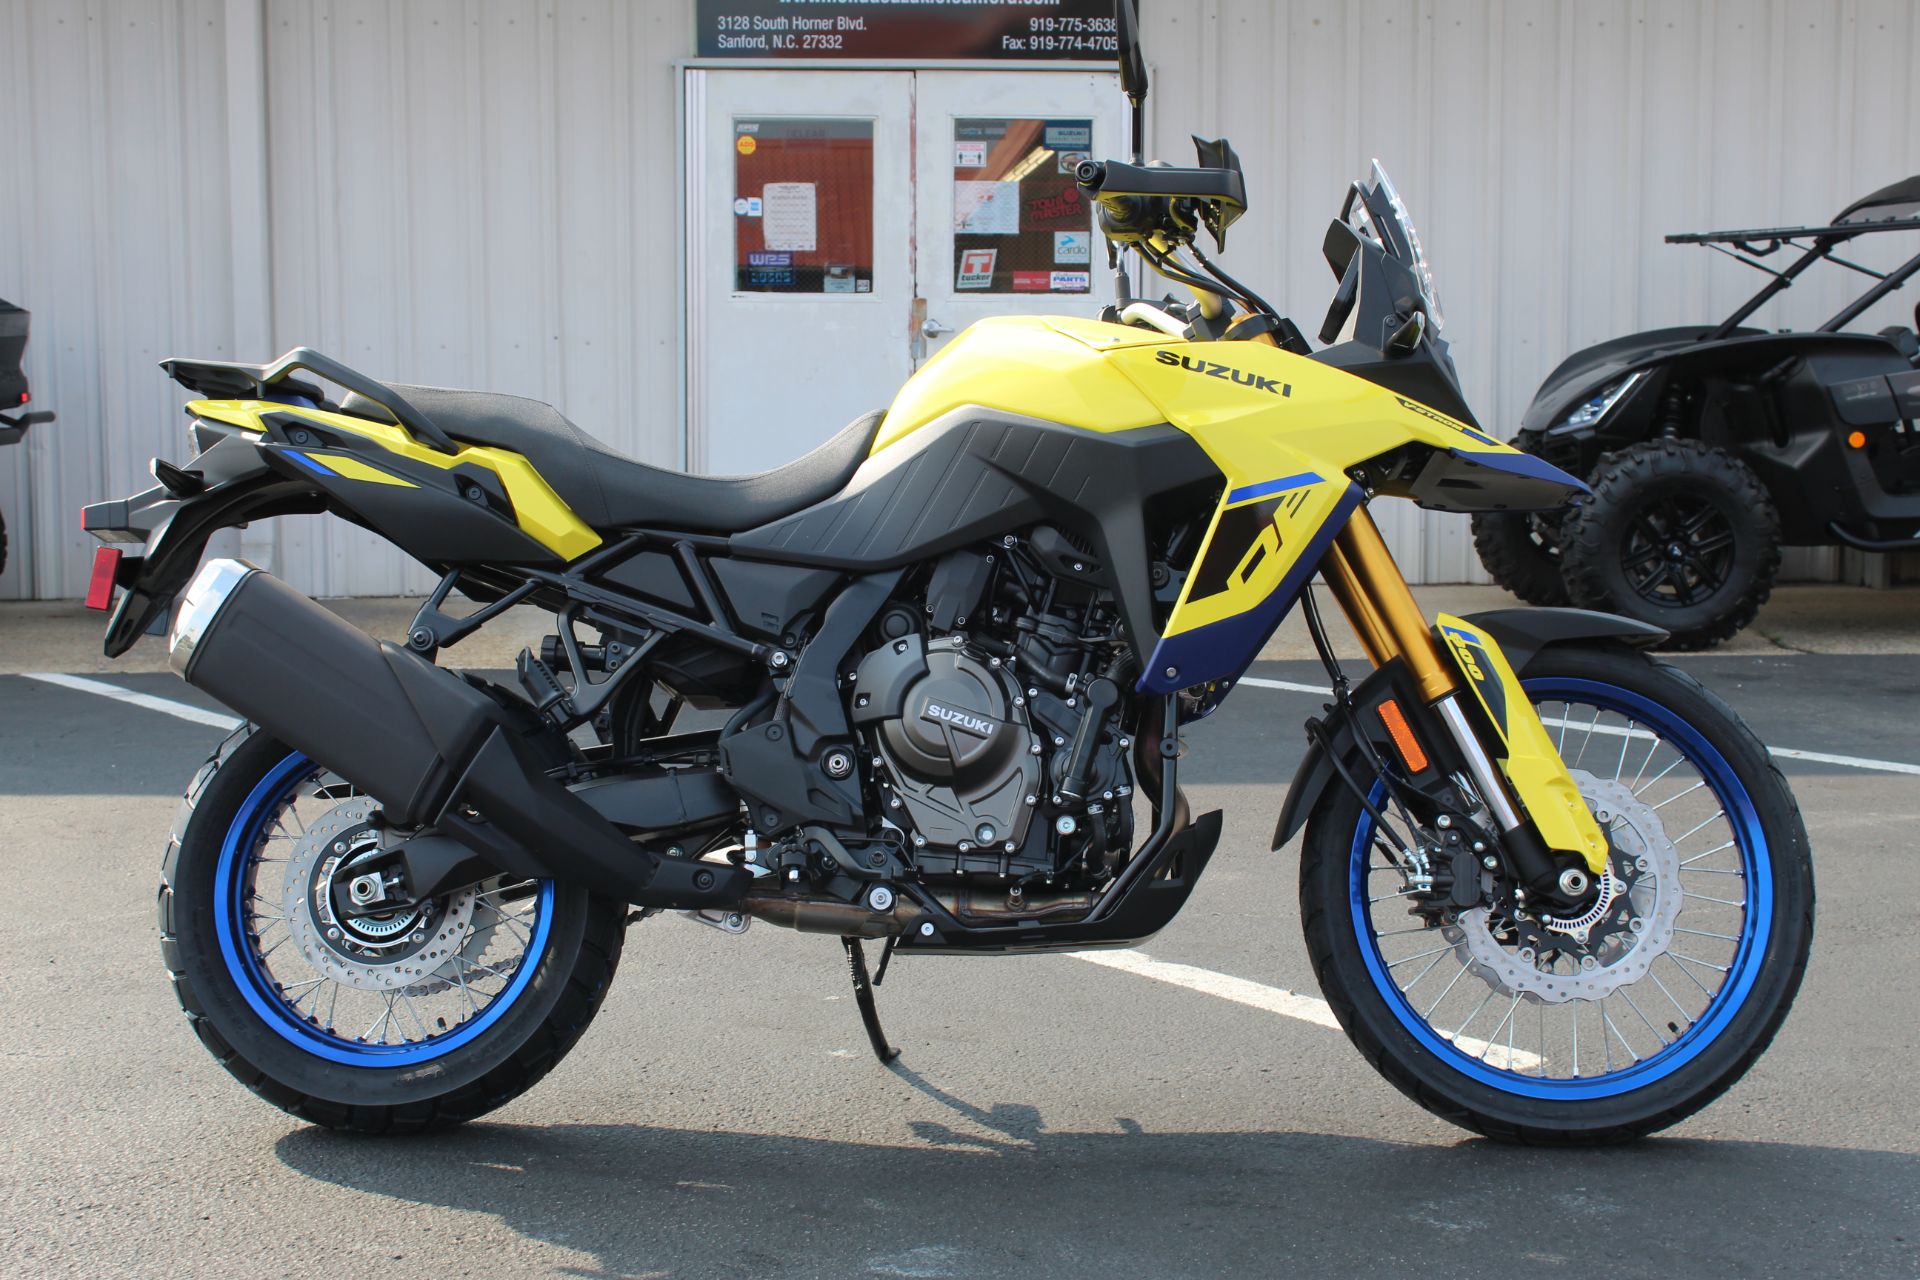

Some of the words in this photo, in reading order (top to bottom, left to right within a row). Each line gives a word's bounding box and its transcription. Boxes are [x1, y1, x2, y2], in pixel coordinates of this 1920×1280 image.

[717, 15, 750, 31] 3128
[753, 15, 789, 31] South
[792, 15, 833, 31] Horner
[837, 15, 867, 31] Blvd.
[1030, 17, 1117, 32] 919-775-3638
[717, 33, 769, 50] Sanford,
[772, 34, 799, 49] N.C.
[802, 34, 843, 49] 27332
[1002, 36, 1026, 50] Fax:
[1030, 36, 1119, 50] 919-774-4705
[1057, 244, 1087, 256] cardo
[749, 253, 791, 265] WPS
[961, 274, 991, 282] tucker
[1154, 350, 1293, 398] SUZUKI
[1448, 631, 1485, 681] 800
[927, 704, 994, 735] SUZUKI
